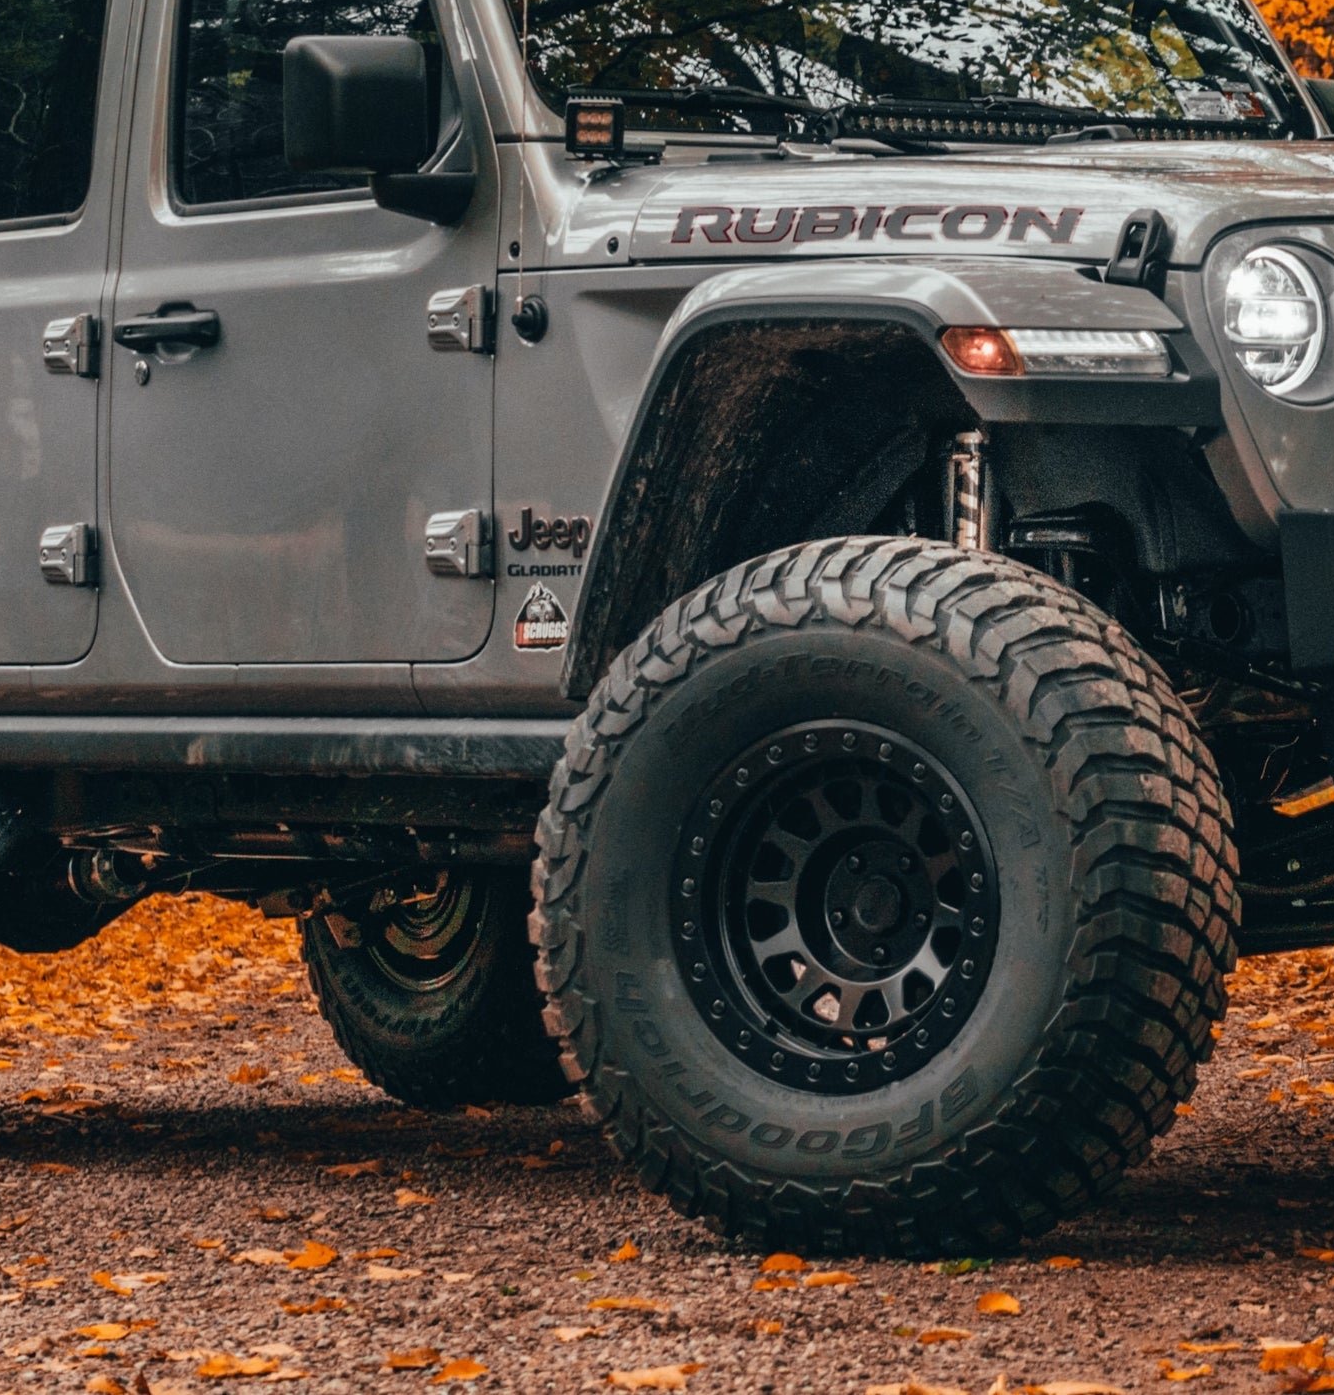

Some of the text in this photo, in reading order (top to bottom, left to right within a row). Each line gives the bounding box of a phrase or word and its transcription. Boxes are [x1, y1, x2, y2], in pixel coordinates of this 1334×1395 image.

[670, 205, 1085, 244] RUBICON
[508, 506, 593, 558] Jeep
[615, 970, 980, 1159] BFGoodrich
